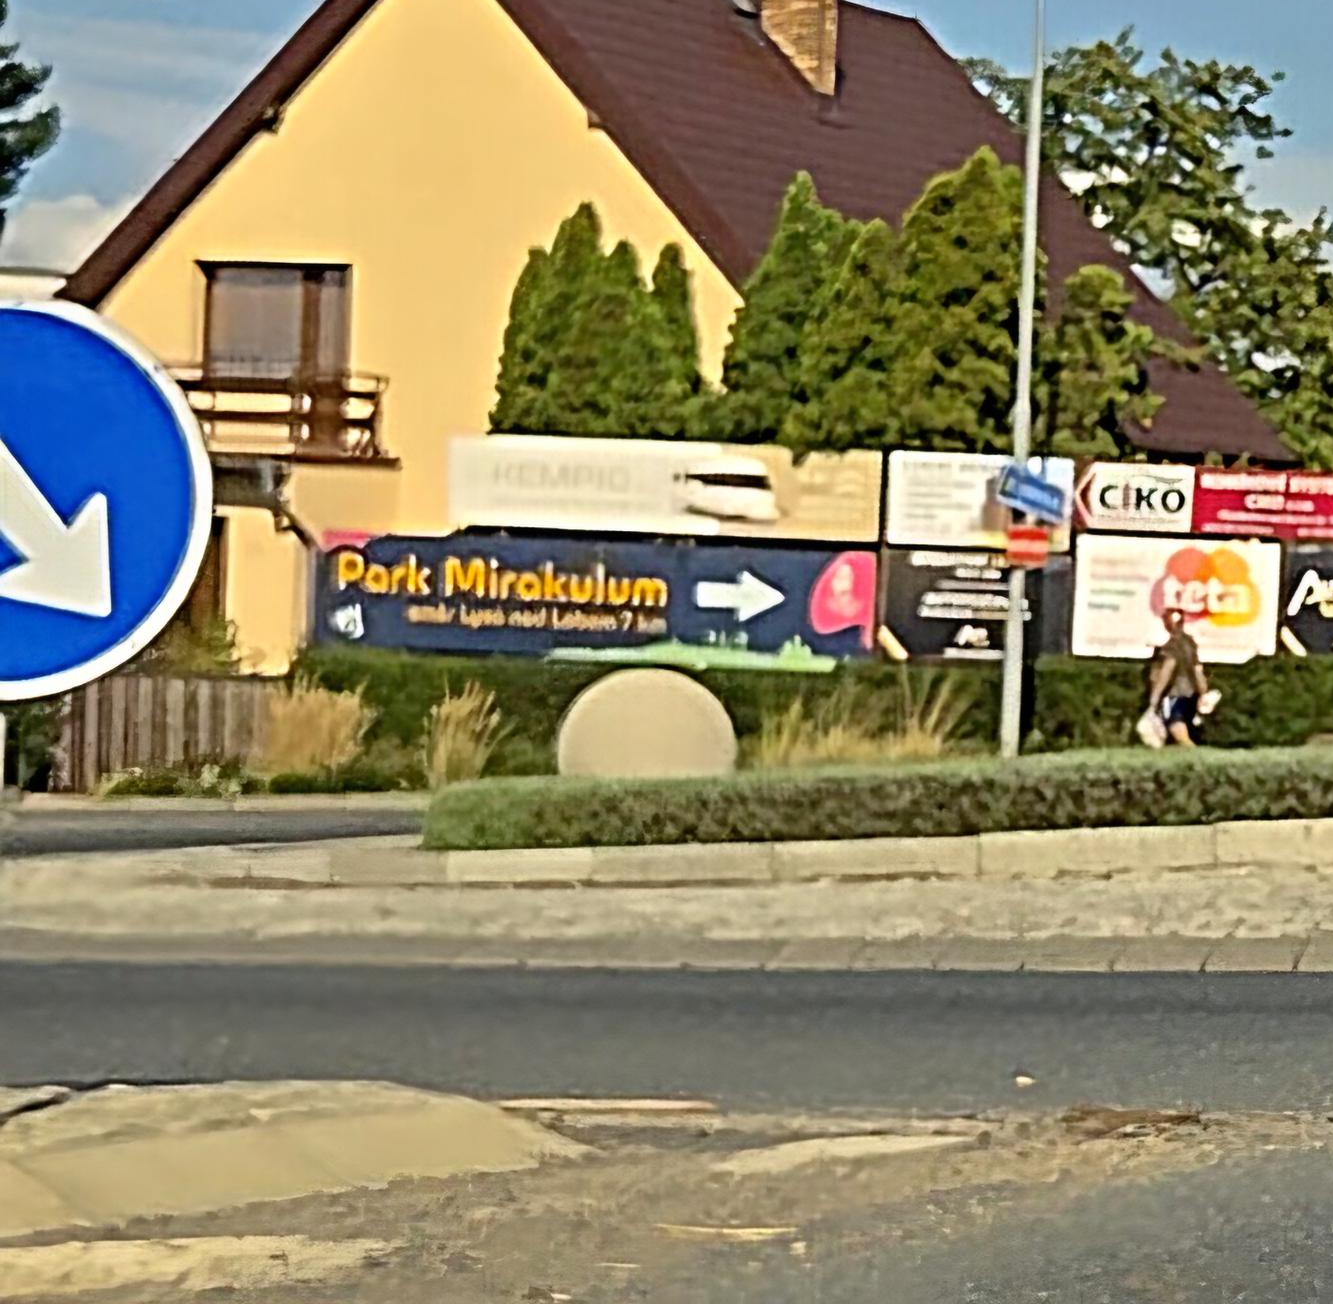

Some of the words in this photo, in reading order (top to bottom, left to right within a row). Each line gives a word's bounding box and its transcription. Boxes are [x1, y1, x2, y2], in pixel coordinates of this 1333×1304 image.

[1099, 482, 1186, 513] CIKO
[338, 552, 431, 596] Park
[444, 555, 667, 608] Mirakulum
